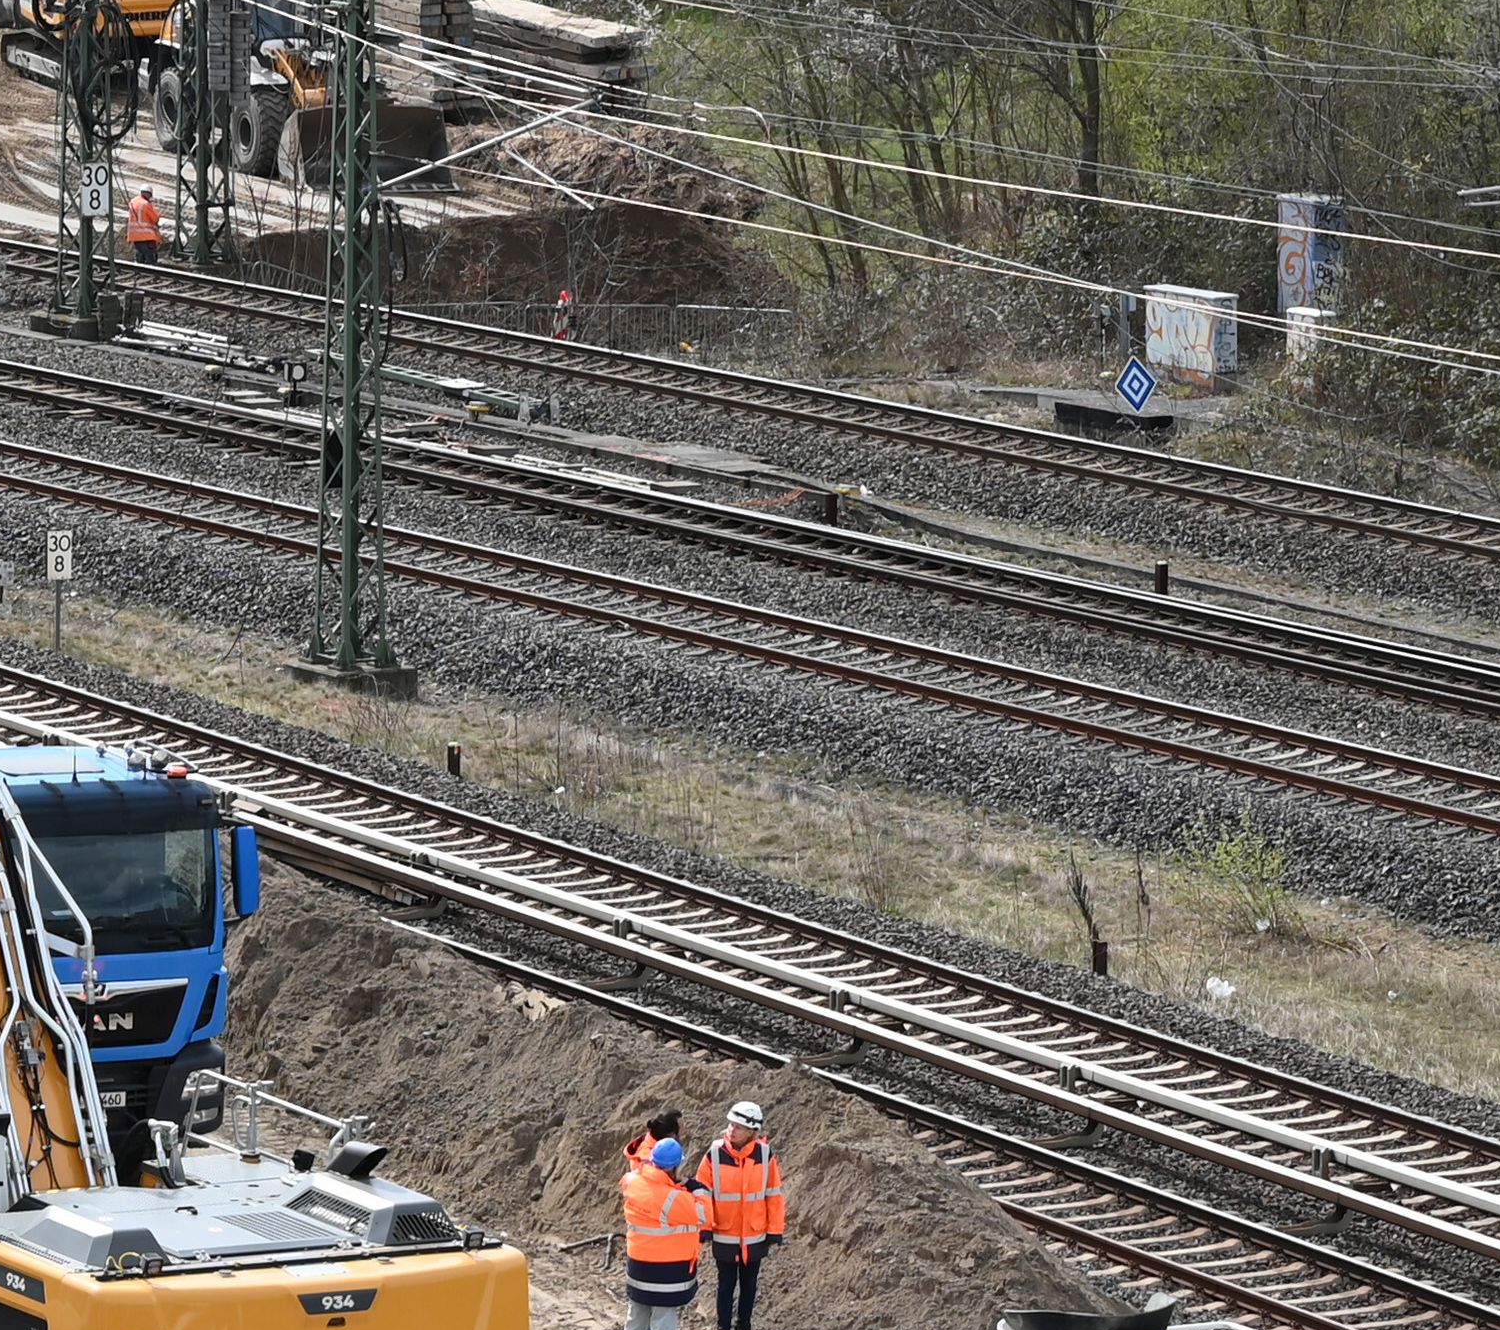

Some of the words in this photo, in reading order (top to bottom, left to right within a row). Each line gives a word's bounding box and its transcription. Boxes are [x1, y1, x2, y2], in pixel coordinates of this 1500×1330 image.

[82, 165, 109, 187] 30
[89, 189, 101, 210] 8
[49, 535, 71, 552] 30
[54, 555, 64, 573] 8
[6, 1272, 26, 1291] 934
[321, 1294, 355, 1310] 934
